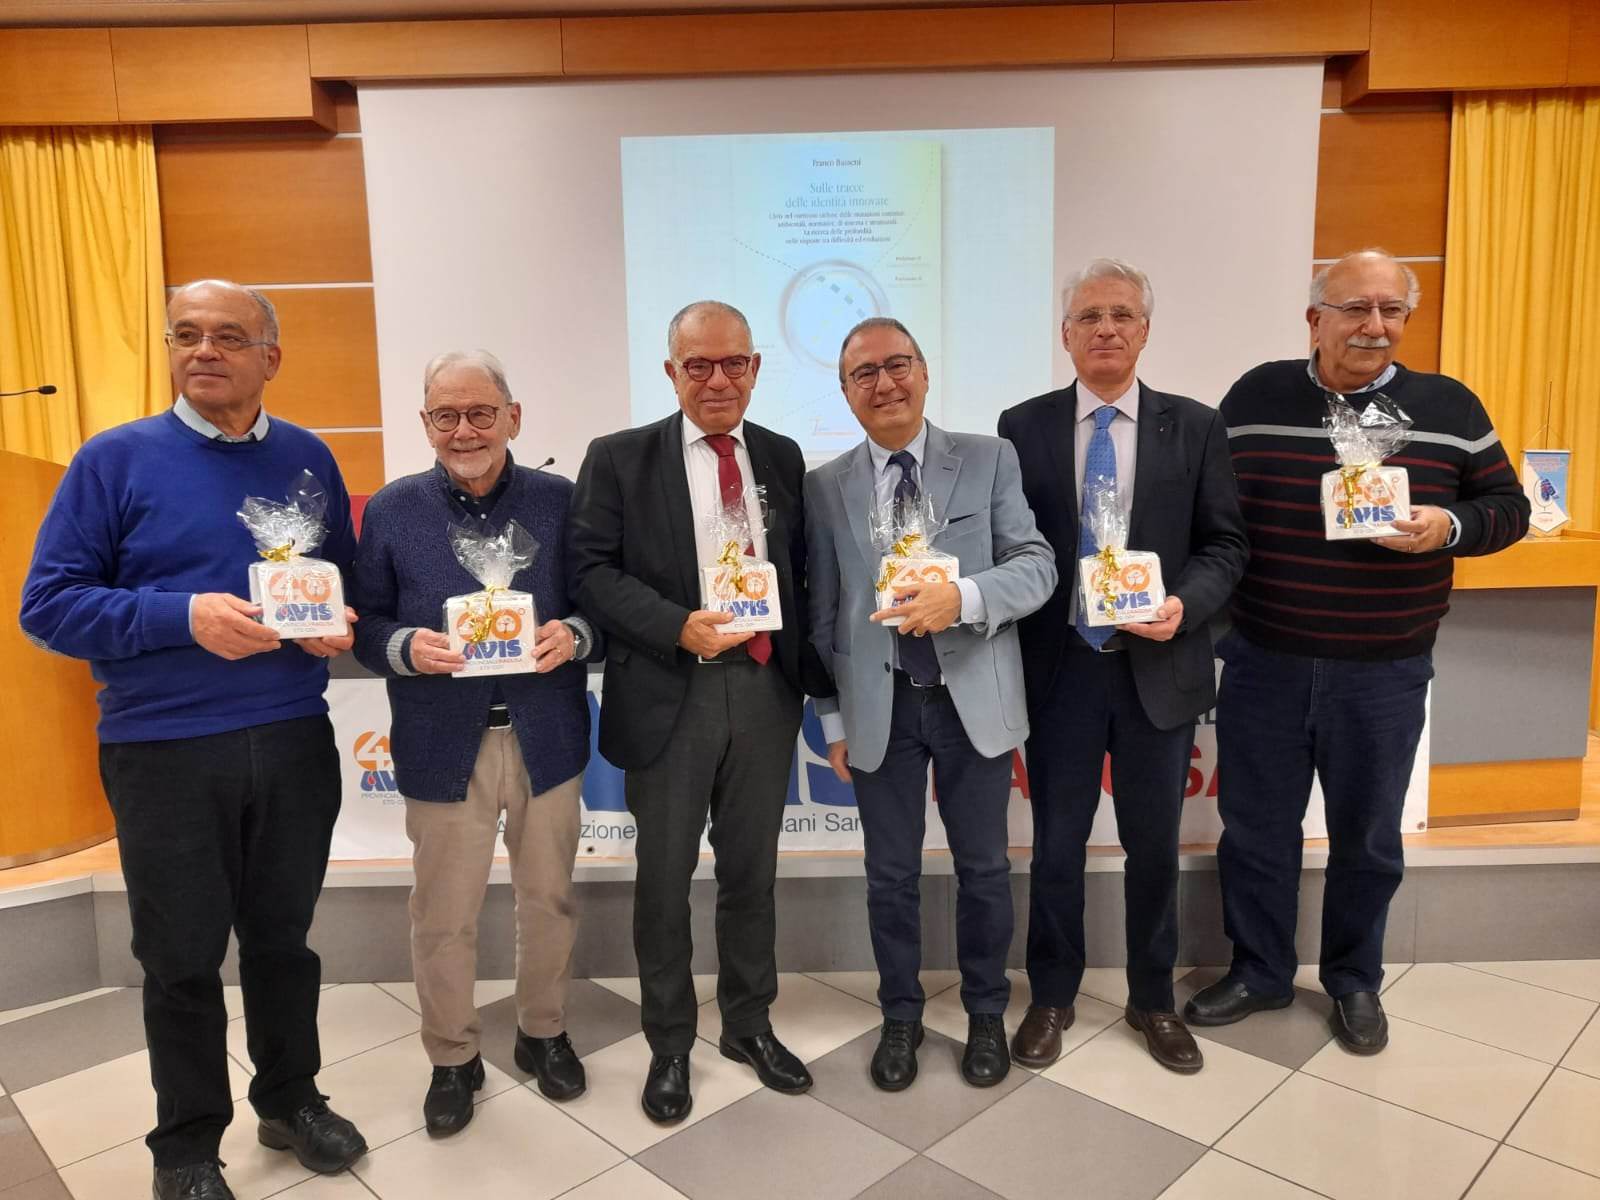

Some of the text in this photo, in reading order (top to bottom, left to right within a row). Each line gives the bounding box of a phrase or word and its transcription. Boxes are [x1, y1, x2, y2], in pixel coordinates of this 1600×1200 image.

[809, 182, 864, 193] Sulle tracce
[785, 196, 808, 208] delle
[849, 196, 888, 207] innovate
[275, 603, 333, 622] AVIS
[462, 639, 523, 660] AVIS
